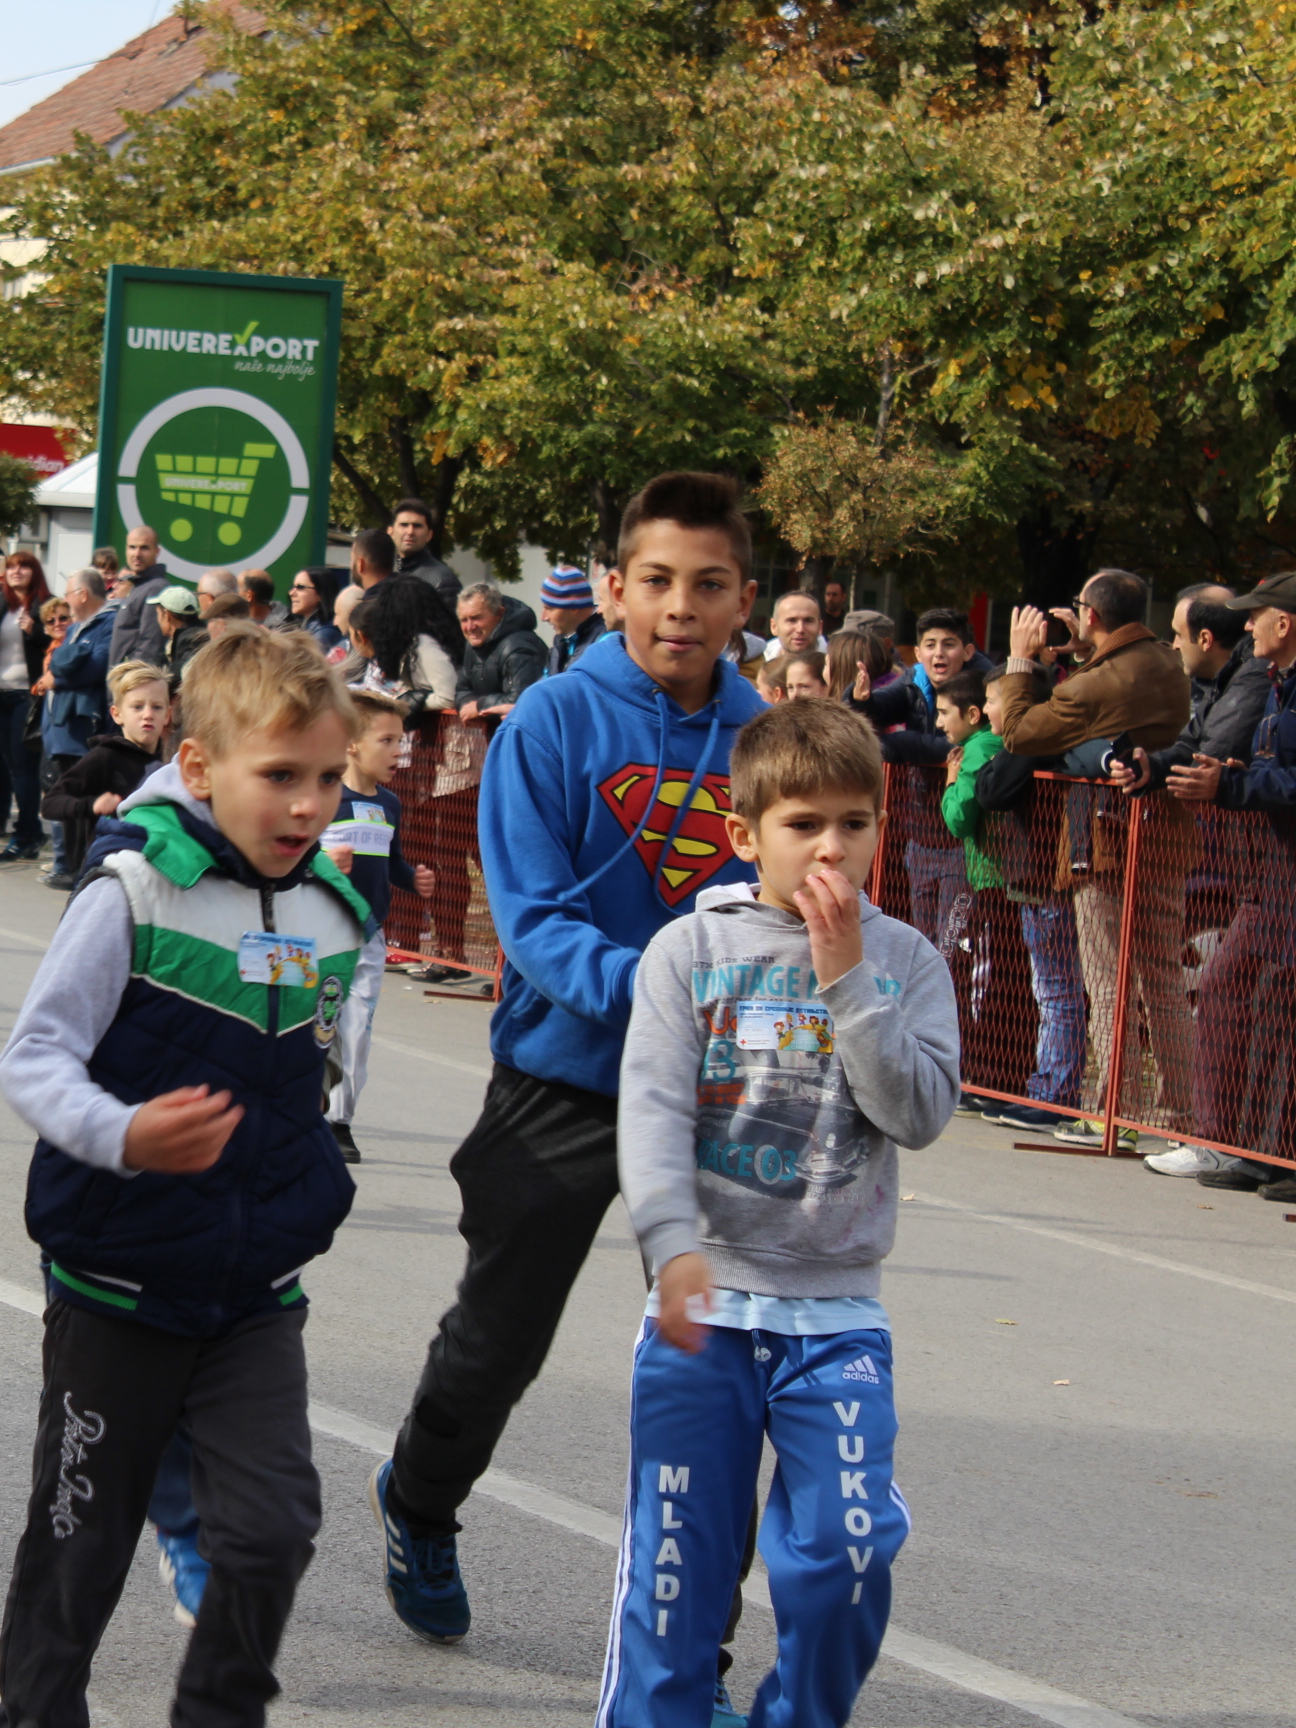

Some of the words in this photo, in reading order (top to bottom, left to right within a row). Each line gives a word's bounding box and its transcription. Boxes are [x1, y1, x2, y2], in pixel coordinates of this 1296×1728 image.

[127, 320, 320, 361] UNIVEREXPORT
[234, 359, 264, 373] naše
[266, 360, 316, 381] najbolje
[741, 955, 775, 964] WEAR
[692, 965, 801, 1002] VINTAGE
[761, 1147, 797, 1182] 03
[842, 1371, 879, 1384] adidas
[833, 1401, 873, 1605] VUKOVI
[655, 1465, 690, 1637] MLADI
